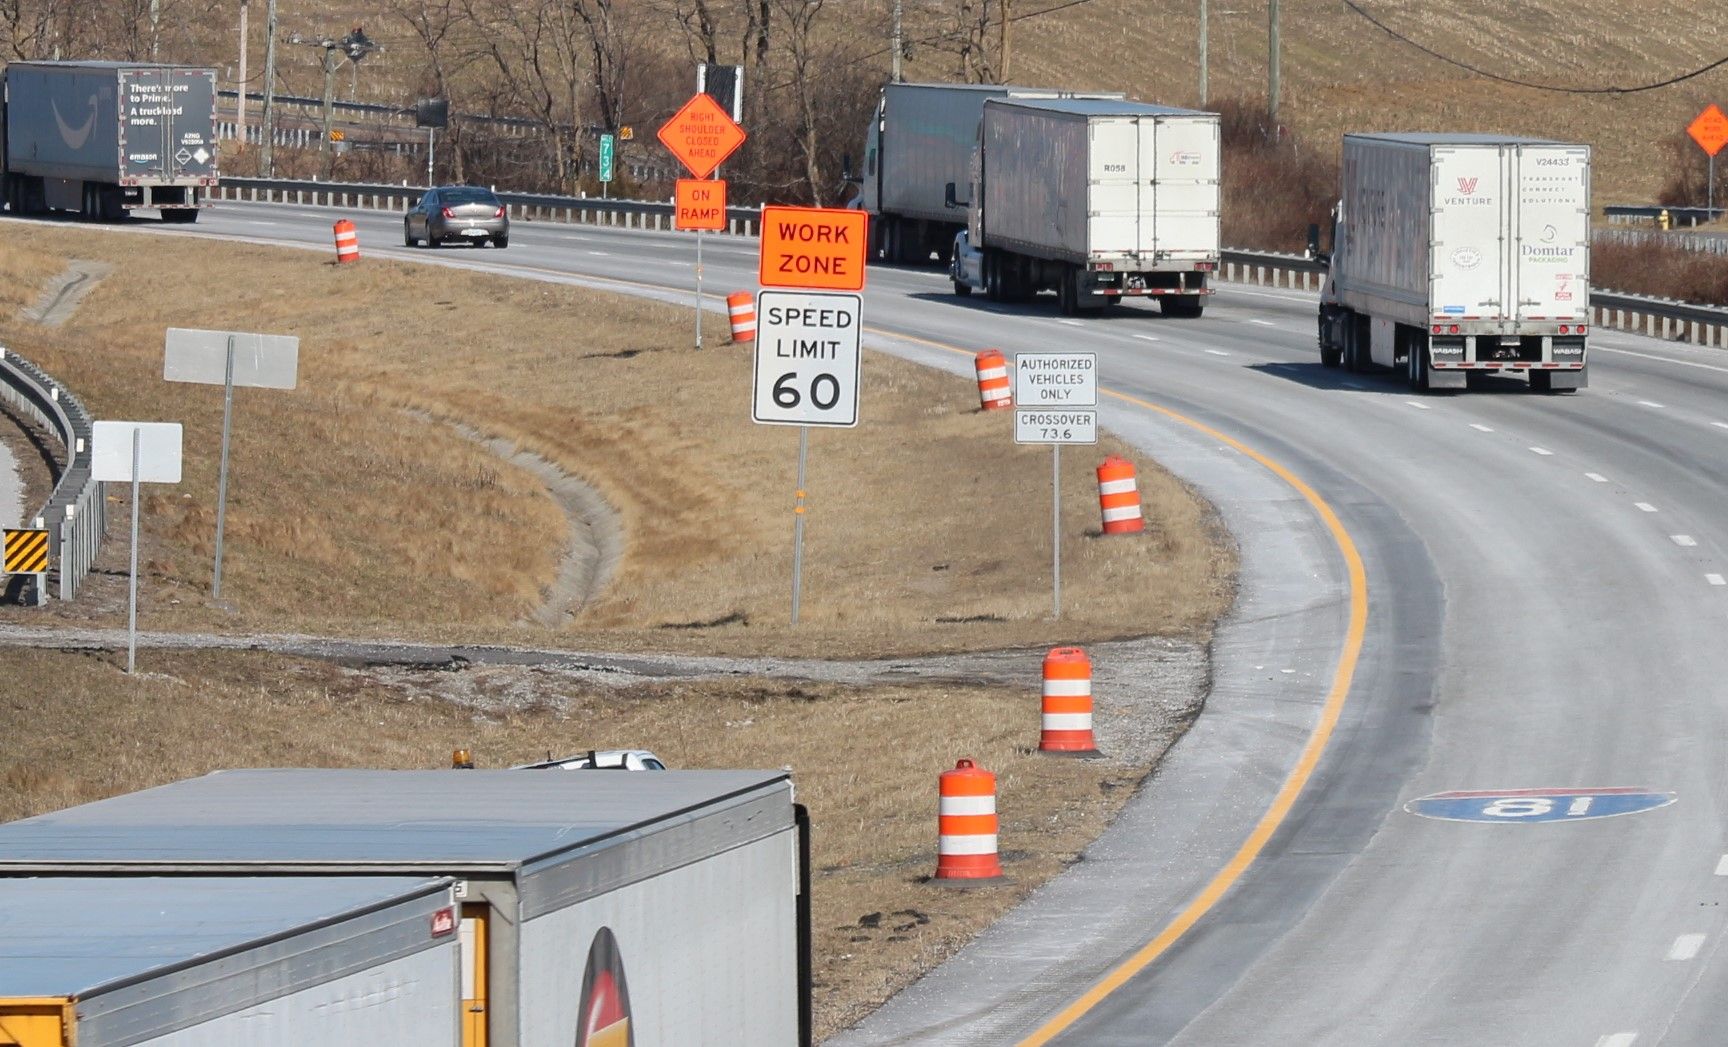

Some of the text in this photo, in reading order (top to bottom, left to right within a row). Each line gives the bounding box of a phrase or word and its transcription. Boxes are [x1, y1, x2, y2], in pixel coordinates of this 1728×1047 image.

[130, 84, 161, 93] There's
[130, 94, 172, 102] to Prime.
[130, 106, 182, 116] A truckload
[130, 118, 158, 126] more.
[691, 112, 714, 122] RIGHT
[680, 125, 725, 134] SHOULDER
[686, 136, 718, 146] CLOSED
[688, 149, 716, 158] AHEAD
[1536, 158, 1570, 166] V24433
[1104, 164, 1126, 172] R058
[692, 190, 710, 201] ON
[1444, 198, 1492, 206] VENTURE
[681, 208, 720, 220] RAMP
[779, 222, 849, 244] WORK
[1522, 244, 1574, 256] Domtar
[779, 254, 847, 274] ZONE
[1528, 256, 1568, 264] PACKAGING
[768, 308, 852, 328] SPEED
[777, 339, 840, 360] LIMIT
[1020, 360, 1092, 370] AUTHORIZED
[1028, 374, 1084, 384] VEHICLES
[772, 372, 840, 410] 60
[1040, 389, 1072, 400] ONLY
[1021, 414, 1091, 425] CROSSOVER
[1040, 428, 1072, 439] 73.6
[1482, 796, 1594, 816] 81
